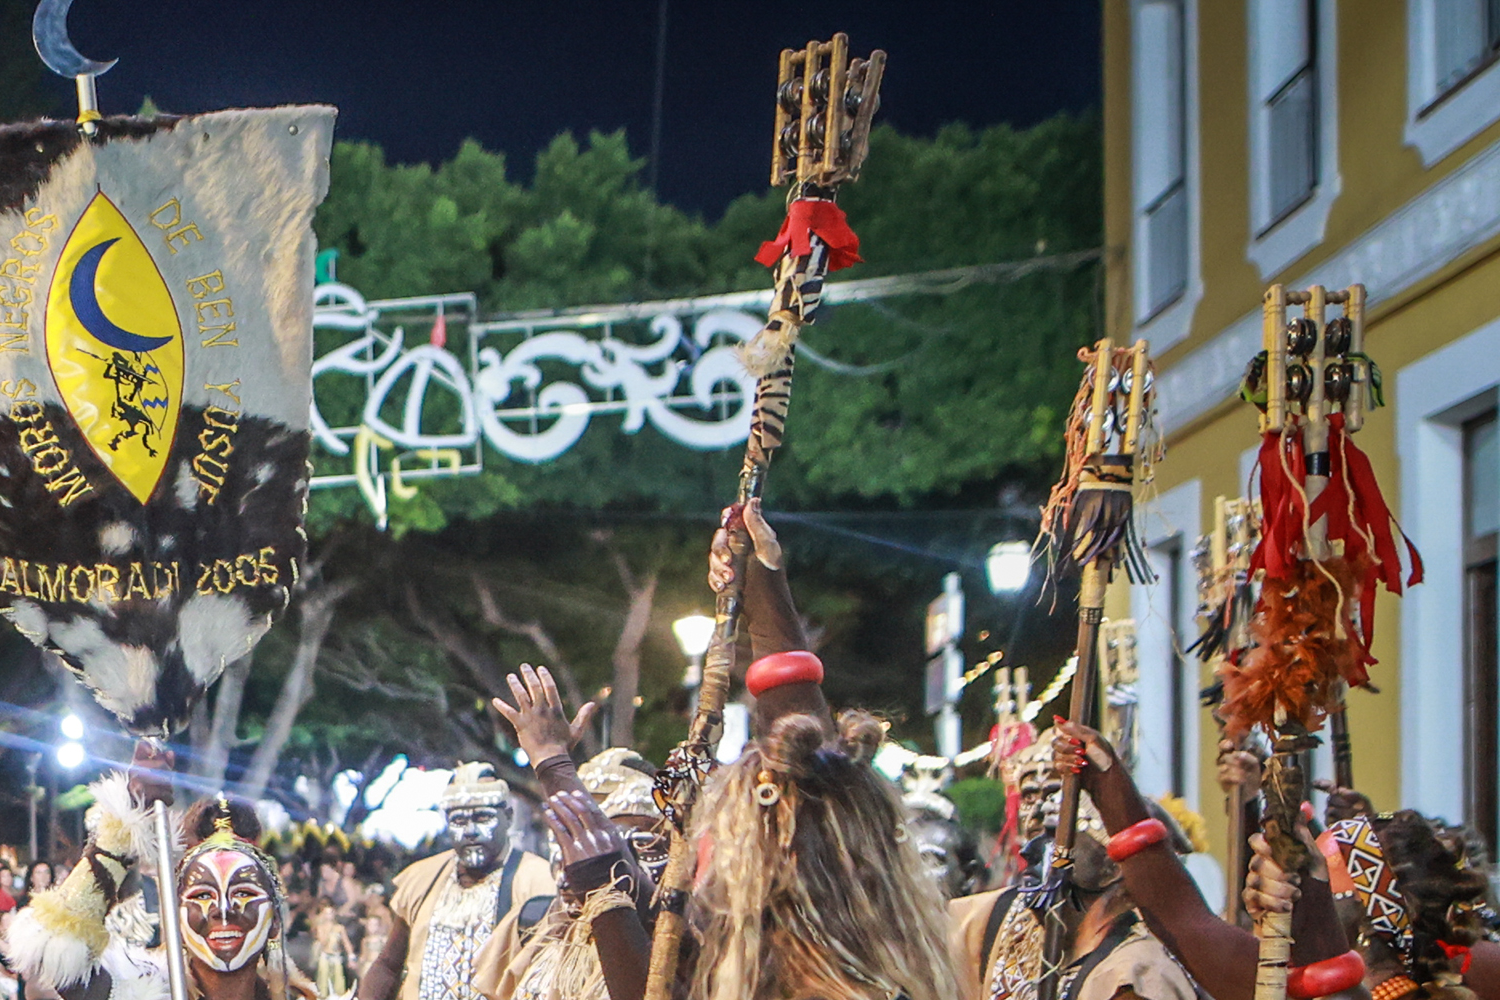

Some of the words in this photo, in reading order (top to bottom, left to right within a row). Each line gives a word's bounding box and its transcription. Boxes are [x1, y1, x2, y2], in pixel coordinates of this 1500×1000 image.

[148, 196, 204, 255] DE
[185, 268, 240, 349] BEN
[1, 377, 95, 507] MOROS
[191, 377, 242, 506] YUSUF
[196, 545, 279, 596] 2005
